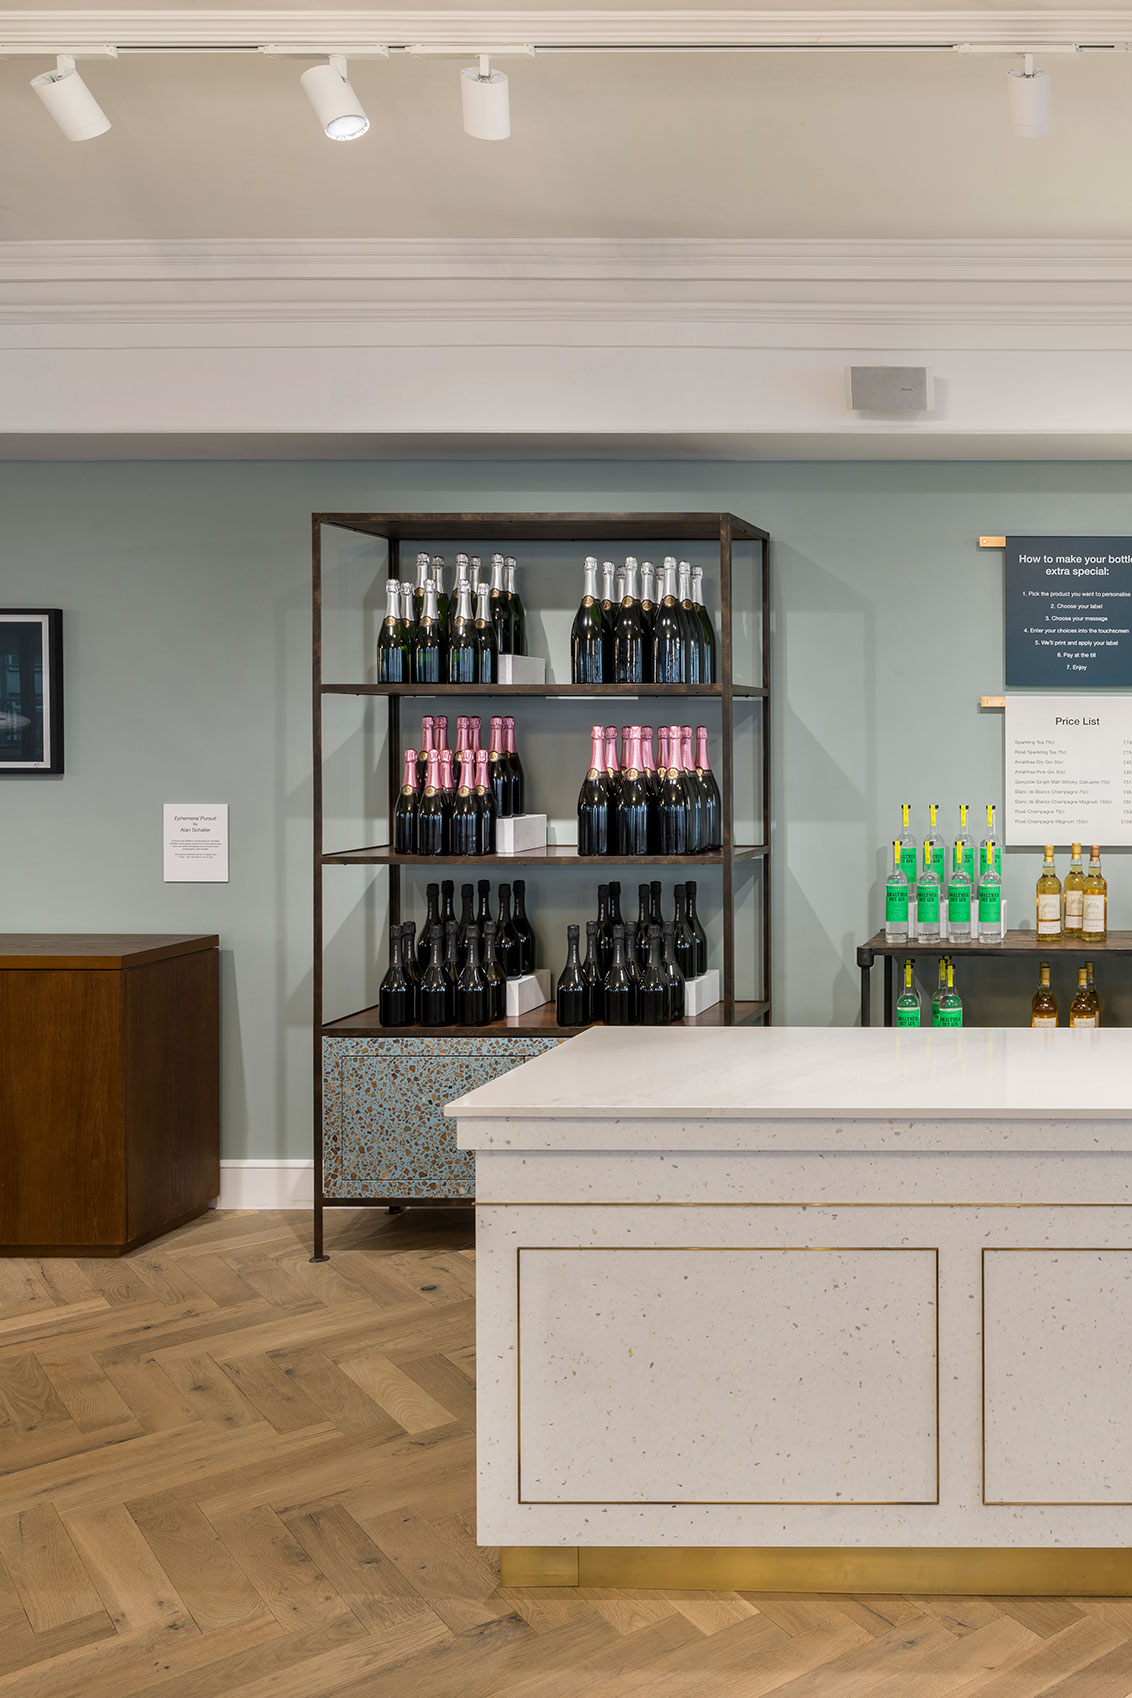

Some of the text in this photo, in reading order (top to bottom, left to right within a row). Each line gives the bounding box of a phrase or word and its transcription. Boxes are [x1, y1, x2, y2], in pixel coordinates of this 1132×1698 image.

[1019, 554, 1041, 563] How
[1043, 555, 1054, 563] to
[1056, 555, 1082, 563] make
[1084, 556, 1106, 565] your
[1045, 567, 1109, 577] extra special:
